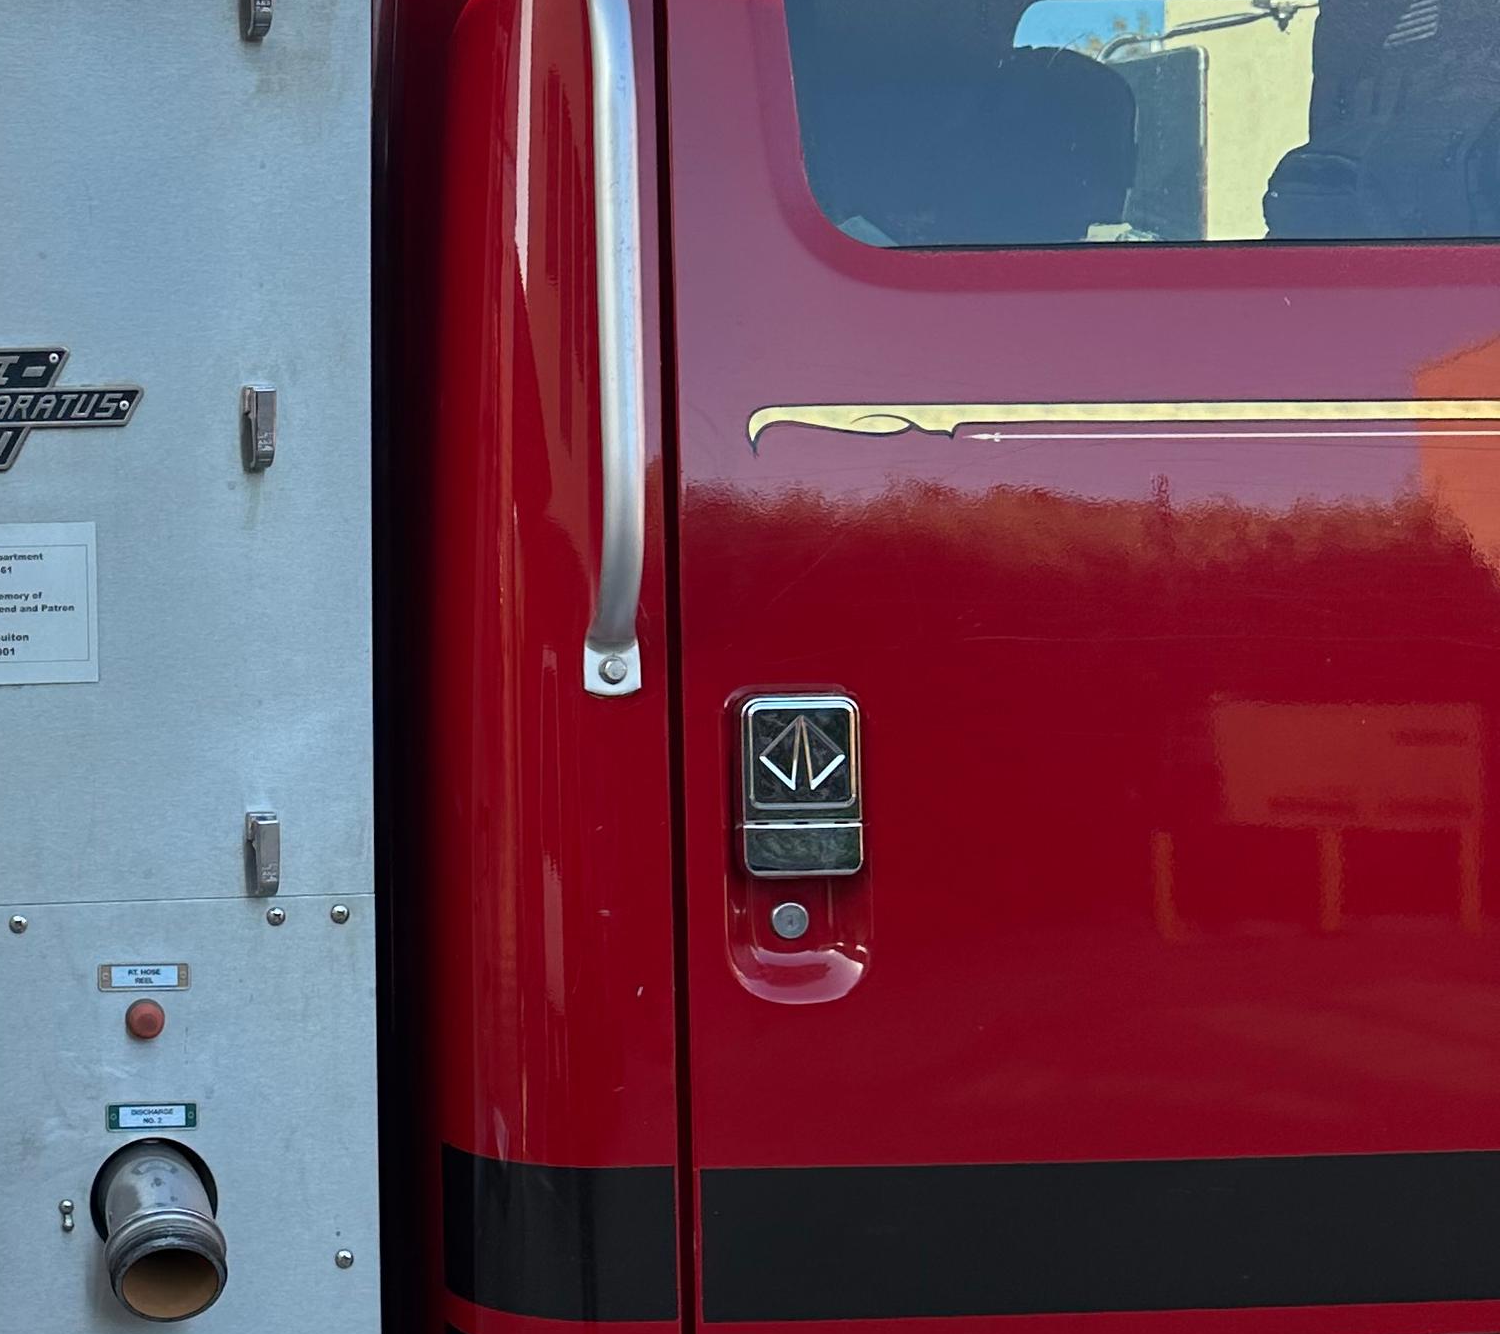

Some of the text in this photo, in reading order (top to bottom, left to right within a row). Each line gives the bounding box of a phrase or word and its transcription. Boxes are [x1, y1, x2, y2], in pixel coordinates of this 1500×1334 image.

[32, 592, 43, 600] of
[19, 605, 39, 613] and
[41, 604, 75, 612] Patron
[141, 968, 161, 976] HOSE
[130, 1108, 174, 1116] DISCHARGE
